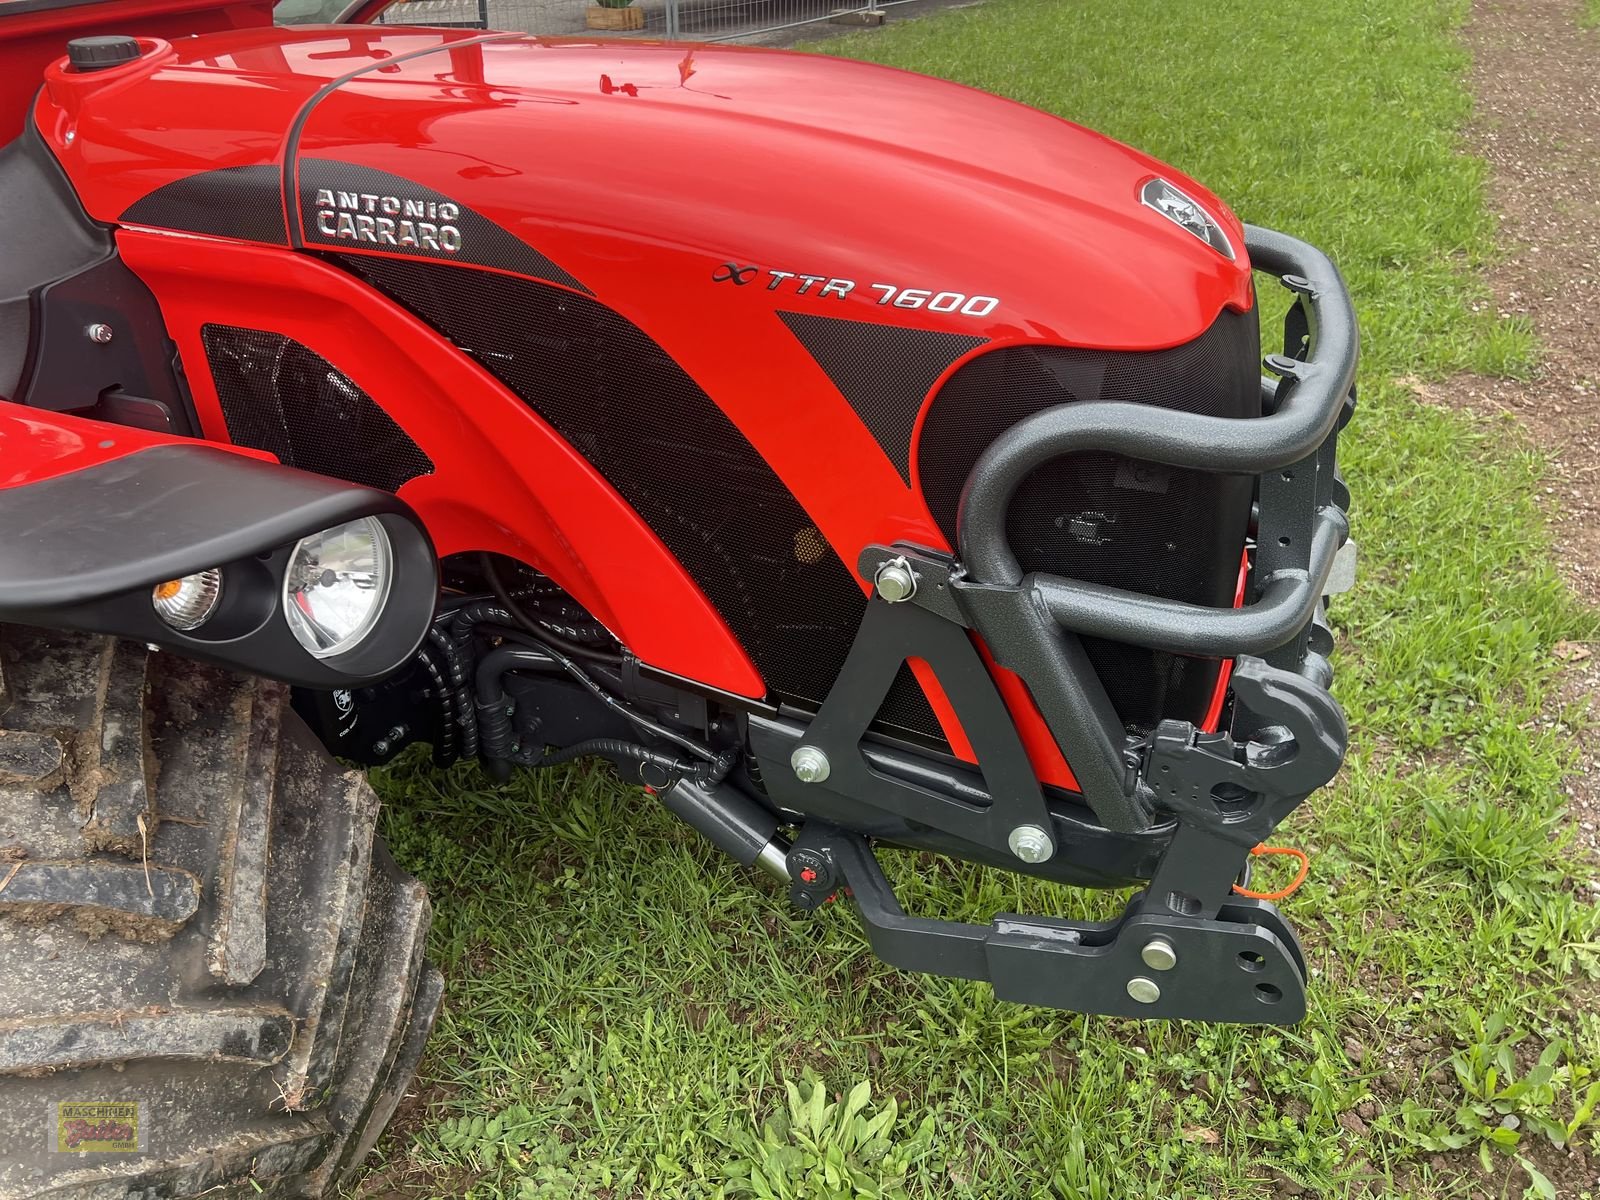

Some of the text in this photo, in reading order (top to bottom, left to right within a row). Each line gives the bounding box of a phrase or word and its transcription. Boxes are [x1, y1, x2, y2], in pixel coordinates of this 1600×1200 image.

[315, 188, 460, 221] ANTONIO
[316, 209, 462, 254] CARRARO
[767, 269, 1000, 317] TTR 7600
